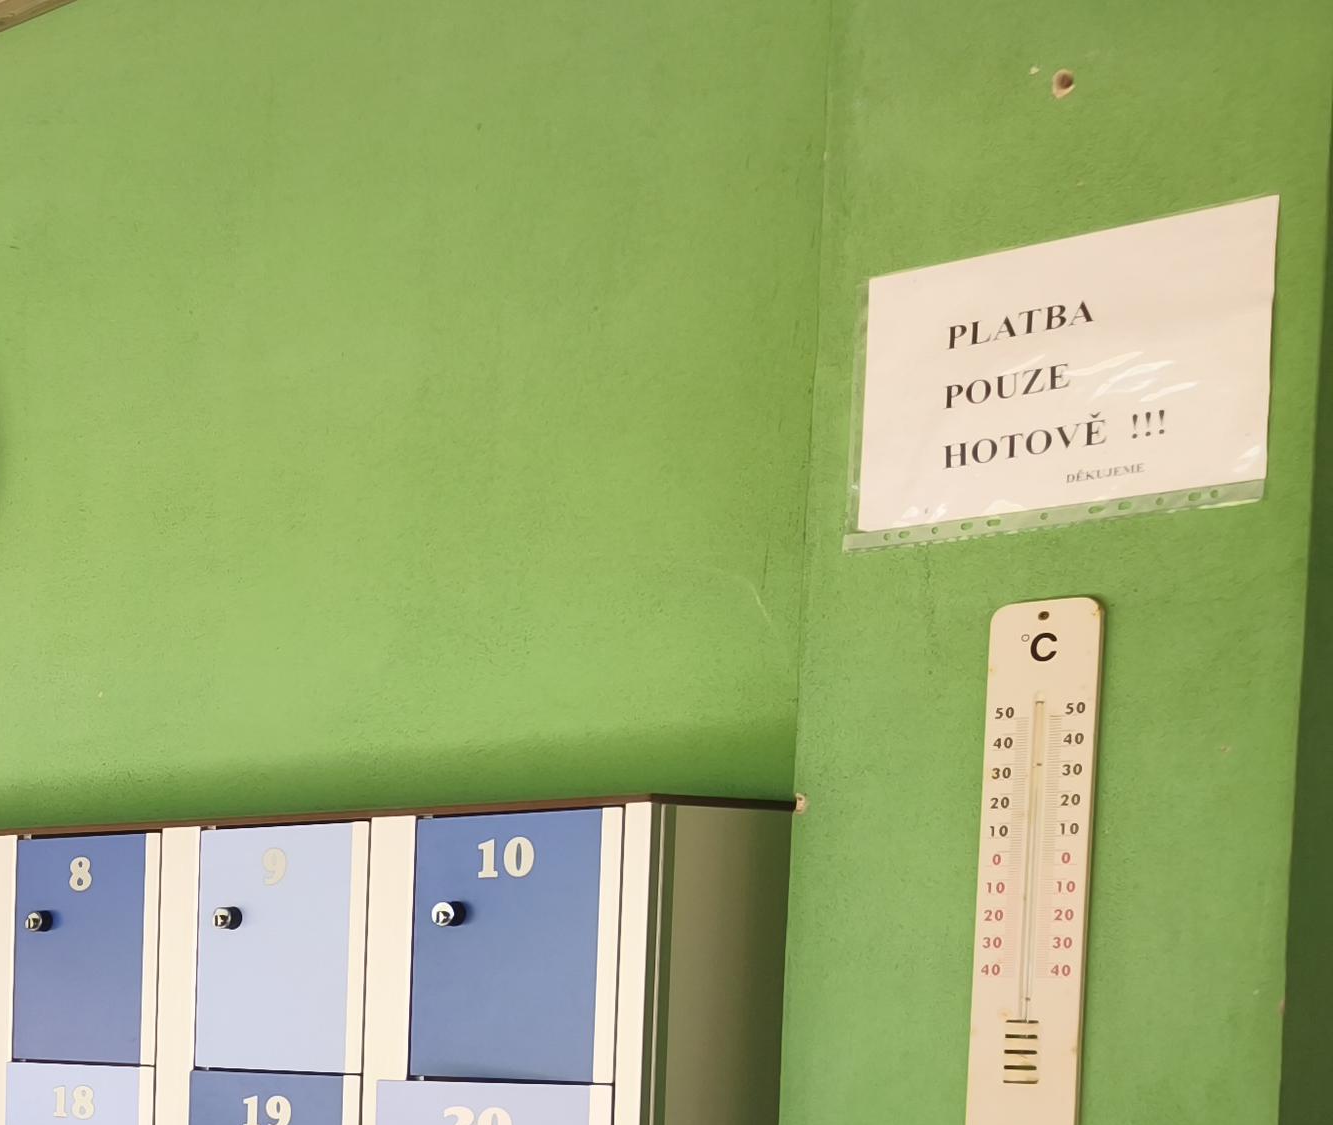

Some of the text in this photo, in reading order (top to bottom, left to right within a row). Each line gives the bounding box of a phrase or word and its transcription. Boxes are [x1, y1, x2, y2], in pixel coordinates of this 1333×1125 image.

[947, 300, 1094, 350] PLATBA
[944, 363, 1071, 409] POUZE
[943, 409, 1166, 470] HOTOVĚ !!!
[1065, 463, 1145, 484] DĚKUJEME
[995, 707, 1015, 719] 50
[1065, 702, 1086, 715] 50
[993, 736, 1013, 750] 40
[1063, 733, 1084, 746] 40
[991, 767, 1012, 780] 30
[1062, 763, 1083, 776] 30
[990, 796, 1010, 809] 20
[1060, 794, 1081, 807] 20
[989, 825, 1008, 838] 10
[1060, 822, 1079, 836] 10
[477, 836, 535, 879] 10
[992, 853, 1001, 866] 0
[1061, 852, 1071, 864] 0
[262, 847, 287, 886] 9
[69, 856, 93, 893] 8
[986, 882, 1005, 894] 10
[1056, 880, 1076, 893] 10
[984, 909, 1004, 922] 20
[1053, 908, 1074, 921] 20
[982, 936, 1002, 949] 30
[1052, 936, 1073, 949] 30
[980, 964, 1001, 977] 40
[1050, 964, 1071, 977] 40
[52, 1085, 96, 1121] 18
